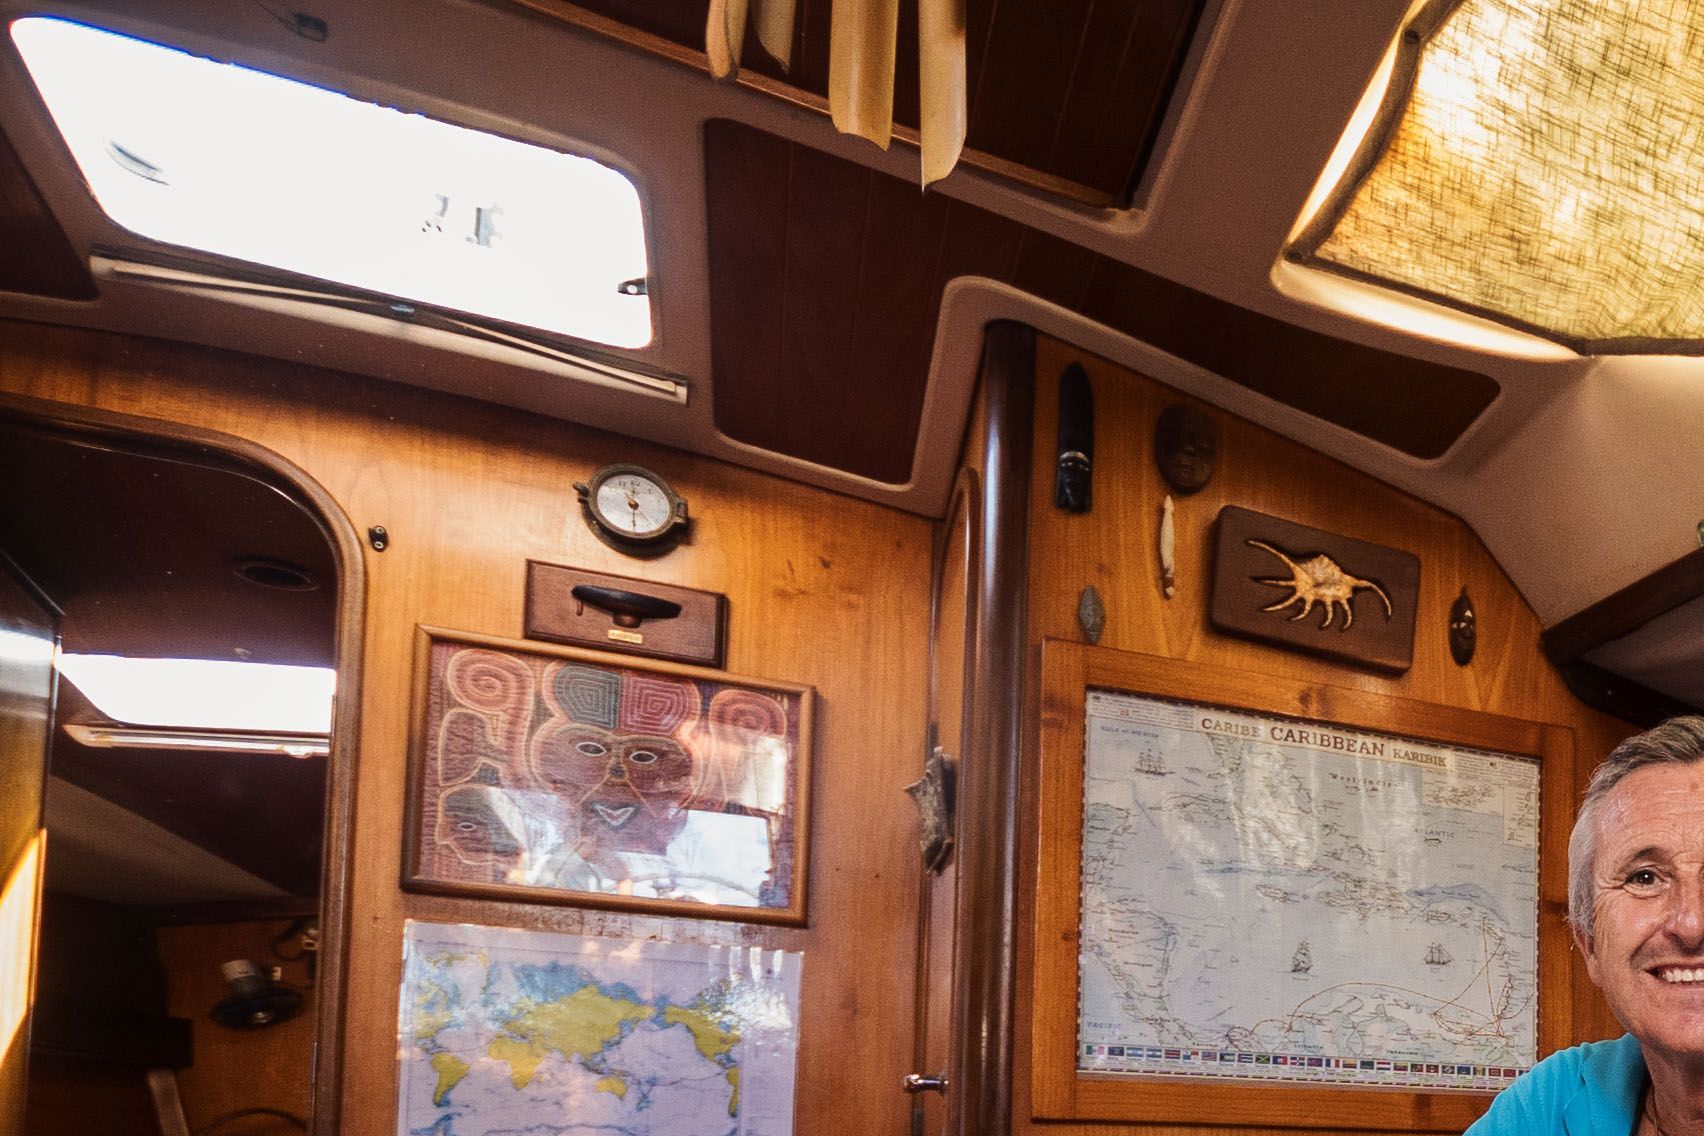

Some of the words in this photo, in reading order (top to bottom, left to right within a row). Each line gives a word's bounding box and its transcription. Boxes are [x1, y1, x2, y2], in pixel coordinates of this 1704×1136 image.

[1201, 718, 1261, 738] CARIBE
[1270, 726, 1385, 757] CARIBBEAN
[1392, 747, 1448, 768] KARIBIK
